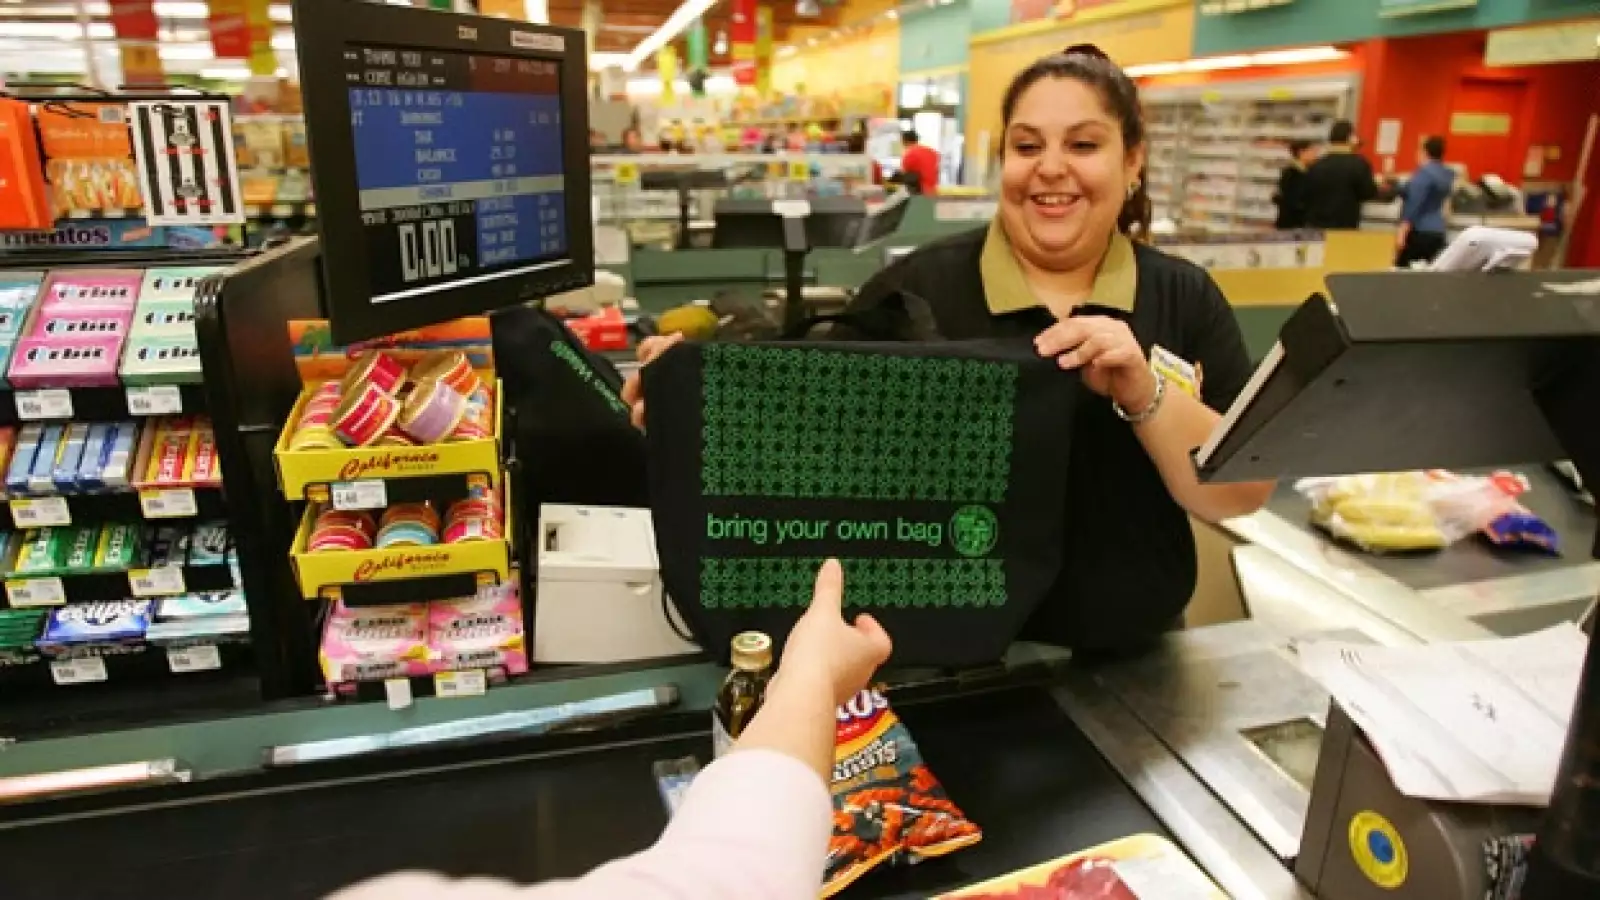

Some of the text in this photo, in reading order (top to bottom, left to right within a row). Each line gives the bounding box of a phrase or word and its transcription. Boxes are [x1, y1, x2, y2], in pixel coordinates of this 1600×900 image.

[2, 225, 110, 245] mentos
[399, 218, 457, 283] 0.00
[337, 452, 439, 480] California
[706, 513, 768, 544] bring
[776, 518, 829, 545] your
[836, 521, 889, 540] own
[897, 517, 942, 546] bag
